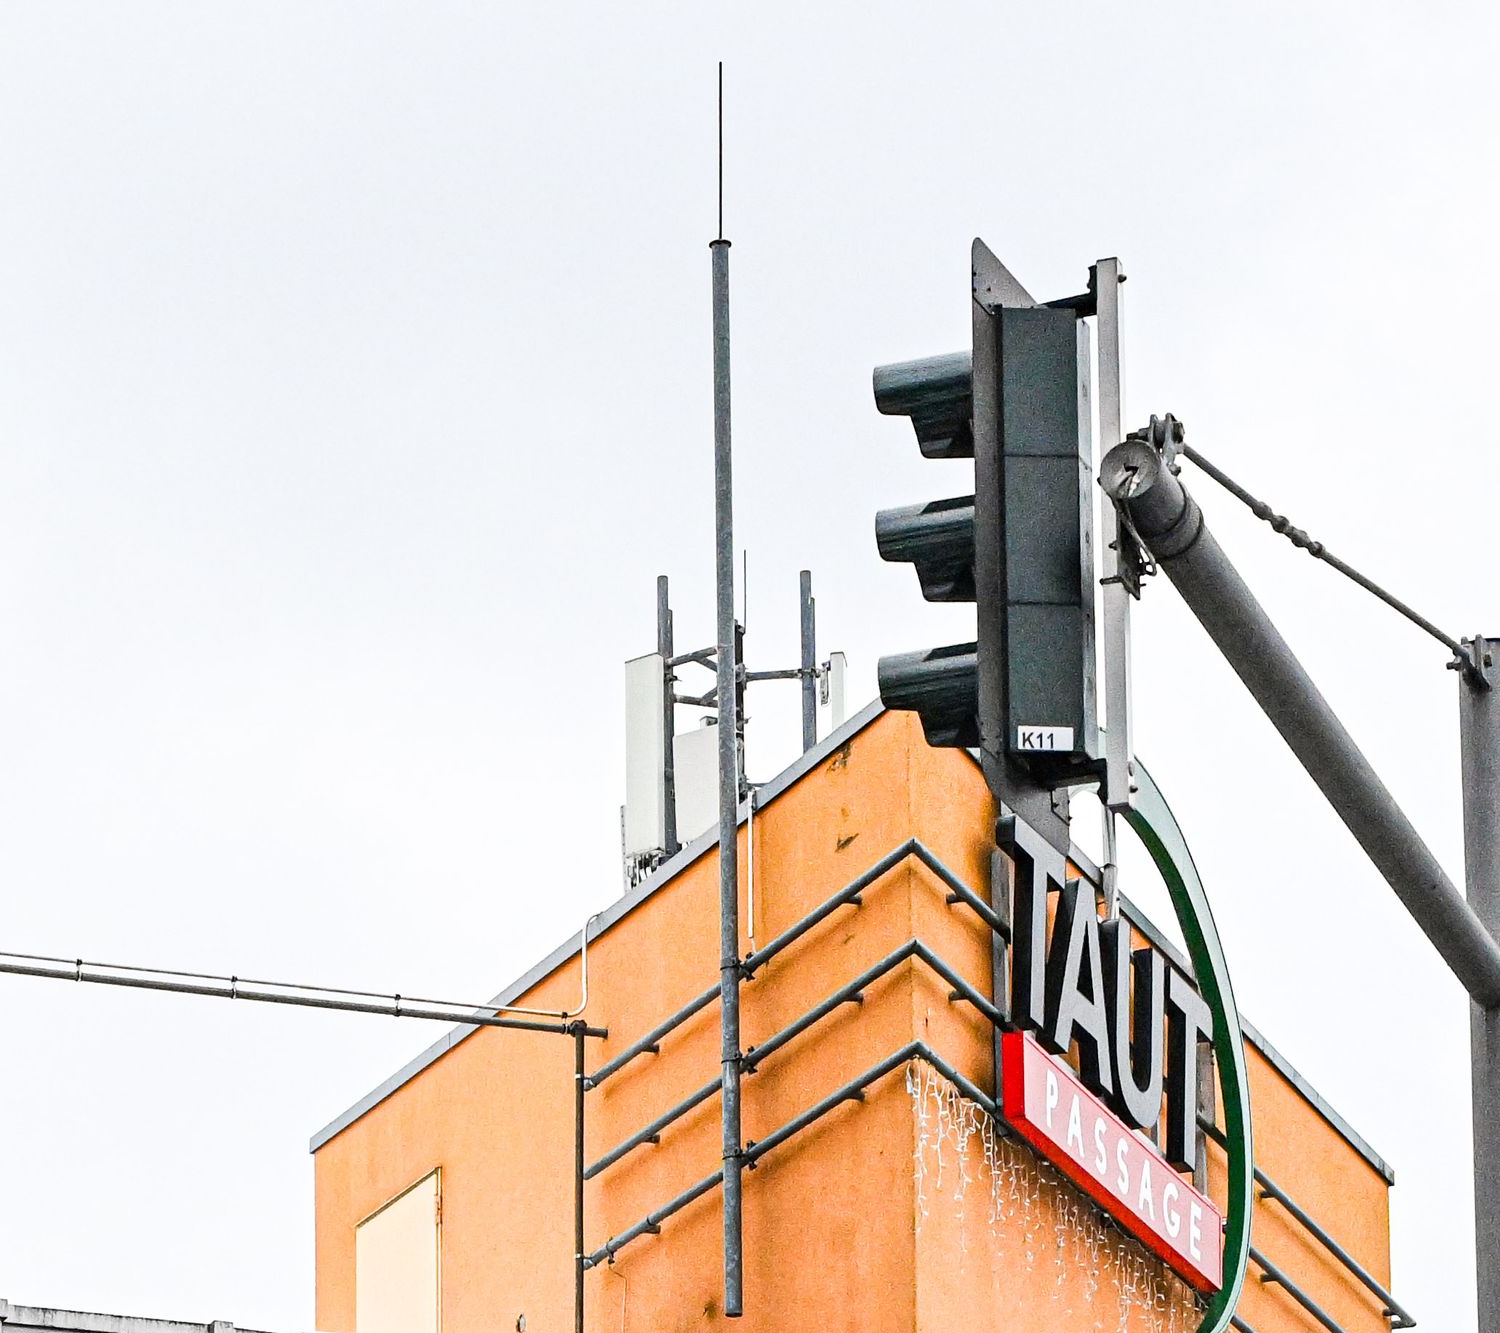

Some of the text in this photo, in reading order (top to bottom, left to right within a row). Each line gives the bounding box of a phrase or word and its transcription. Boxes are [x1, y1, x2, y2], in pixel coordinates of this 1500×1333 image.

[1021, 730, 1055, 750] K11
[997, 813, 1214, 1173] TAUT
[1044, 1070, 1203, 1263] PASSAGE
